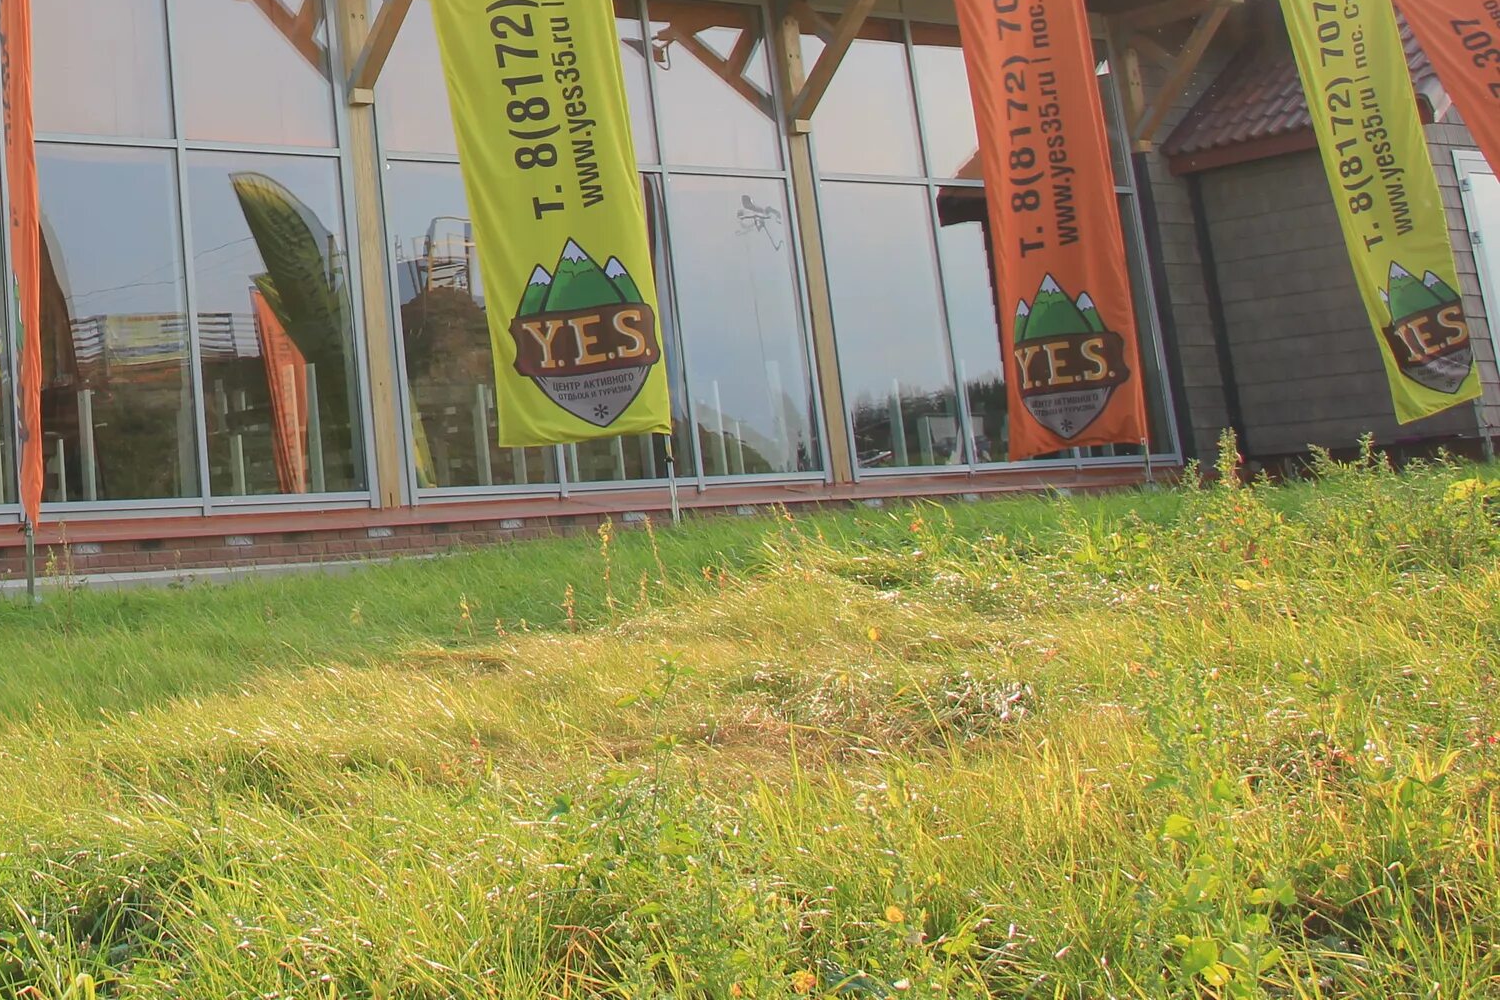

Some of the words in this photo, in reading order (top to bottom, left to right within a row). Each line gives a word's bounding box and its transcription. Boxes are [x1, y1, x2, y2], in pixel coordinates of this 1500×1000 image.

[549, 16, 604, 208] www.yes35.ru
[1351, 24, 1367, 69] пос.
[1001, 55, 1045, 213] 8(8172)
[1038, 71, 1080, 246] www.yes35.ru
[1324, 77, 1374, 215] 8(8172)
[1359, 87, 1414, 236] www.yes35.ru
[521, 309, 651, 368] Y.E.S.
[552, 381, 581, 393] ЦЕНТР
[583, 372, 634, 389] АКТИВНОГО
[1014, 338, 1116, 390] Y.E.S.
